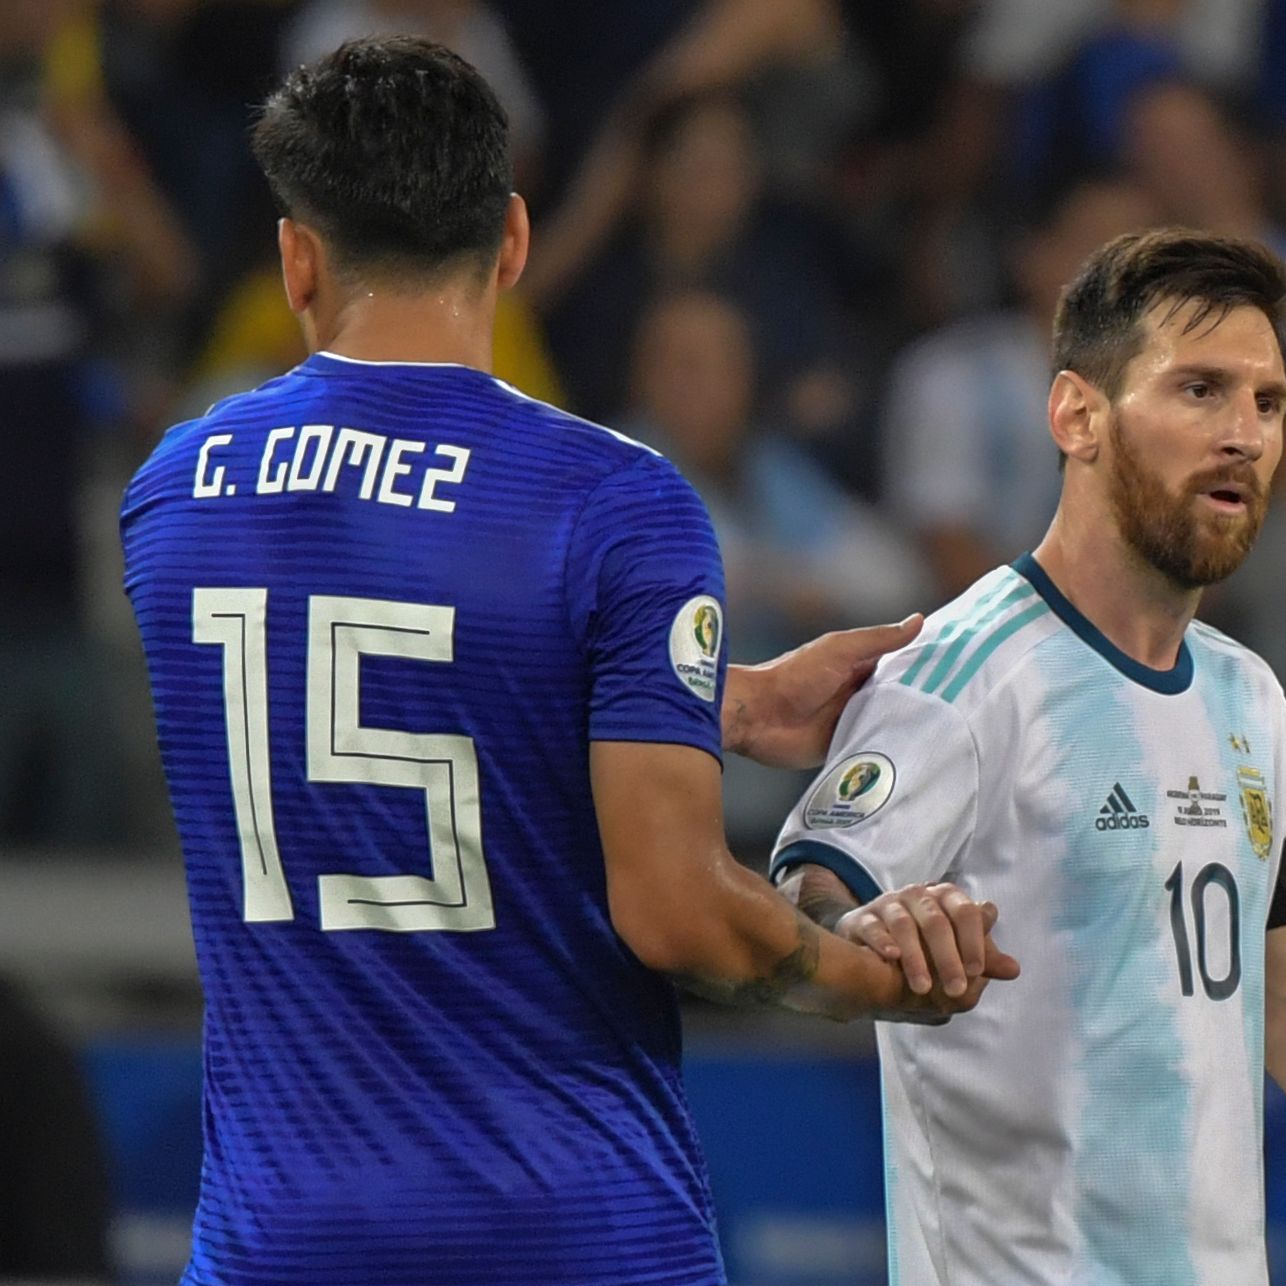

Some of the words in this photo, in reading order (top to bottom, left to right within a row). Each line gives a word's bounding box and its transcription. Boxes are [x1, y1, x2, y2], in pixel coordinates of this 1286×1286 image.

[193, 434, 236, 499] G.
[256, 424, 471, 513] GOMEZ
[192, 587, 496, 932] 15
[1095, 812, 1150, 832] adidas
[1164, 860, 1242, 1002] 10
